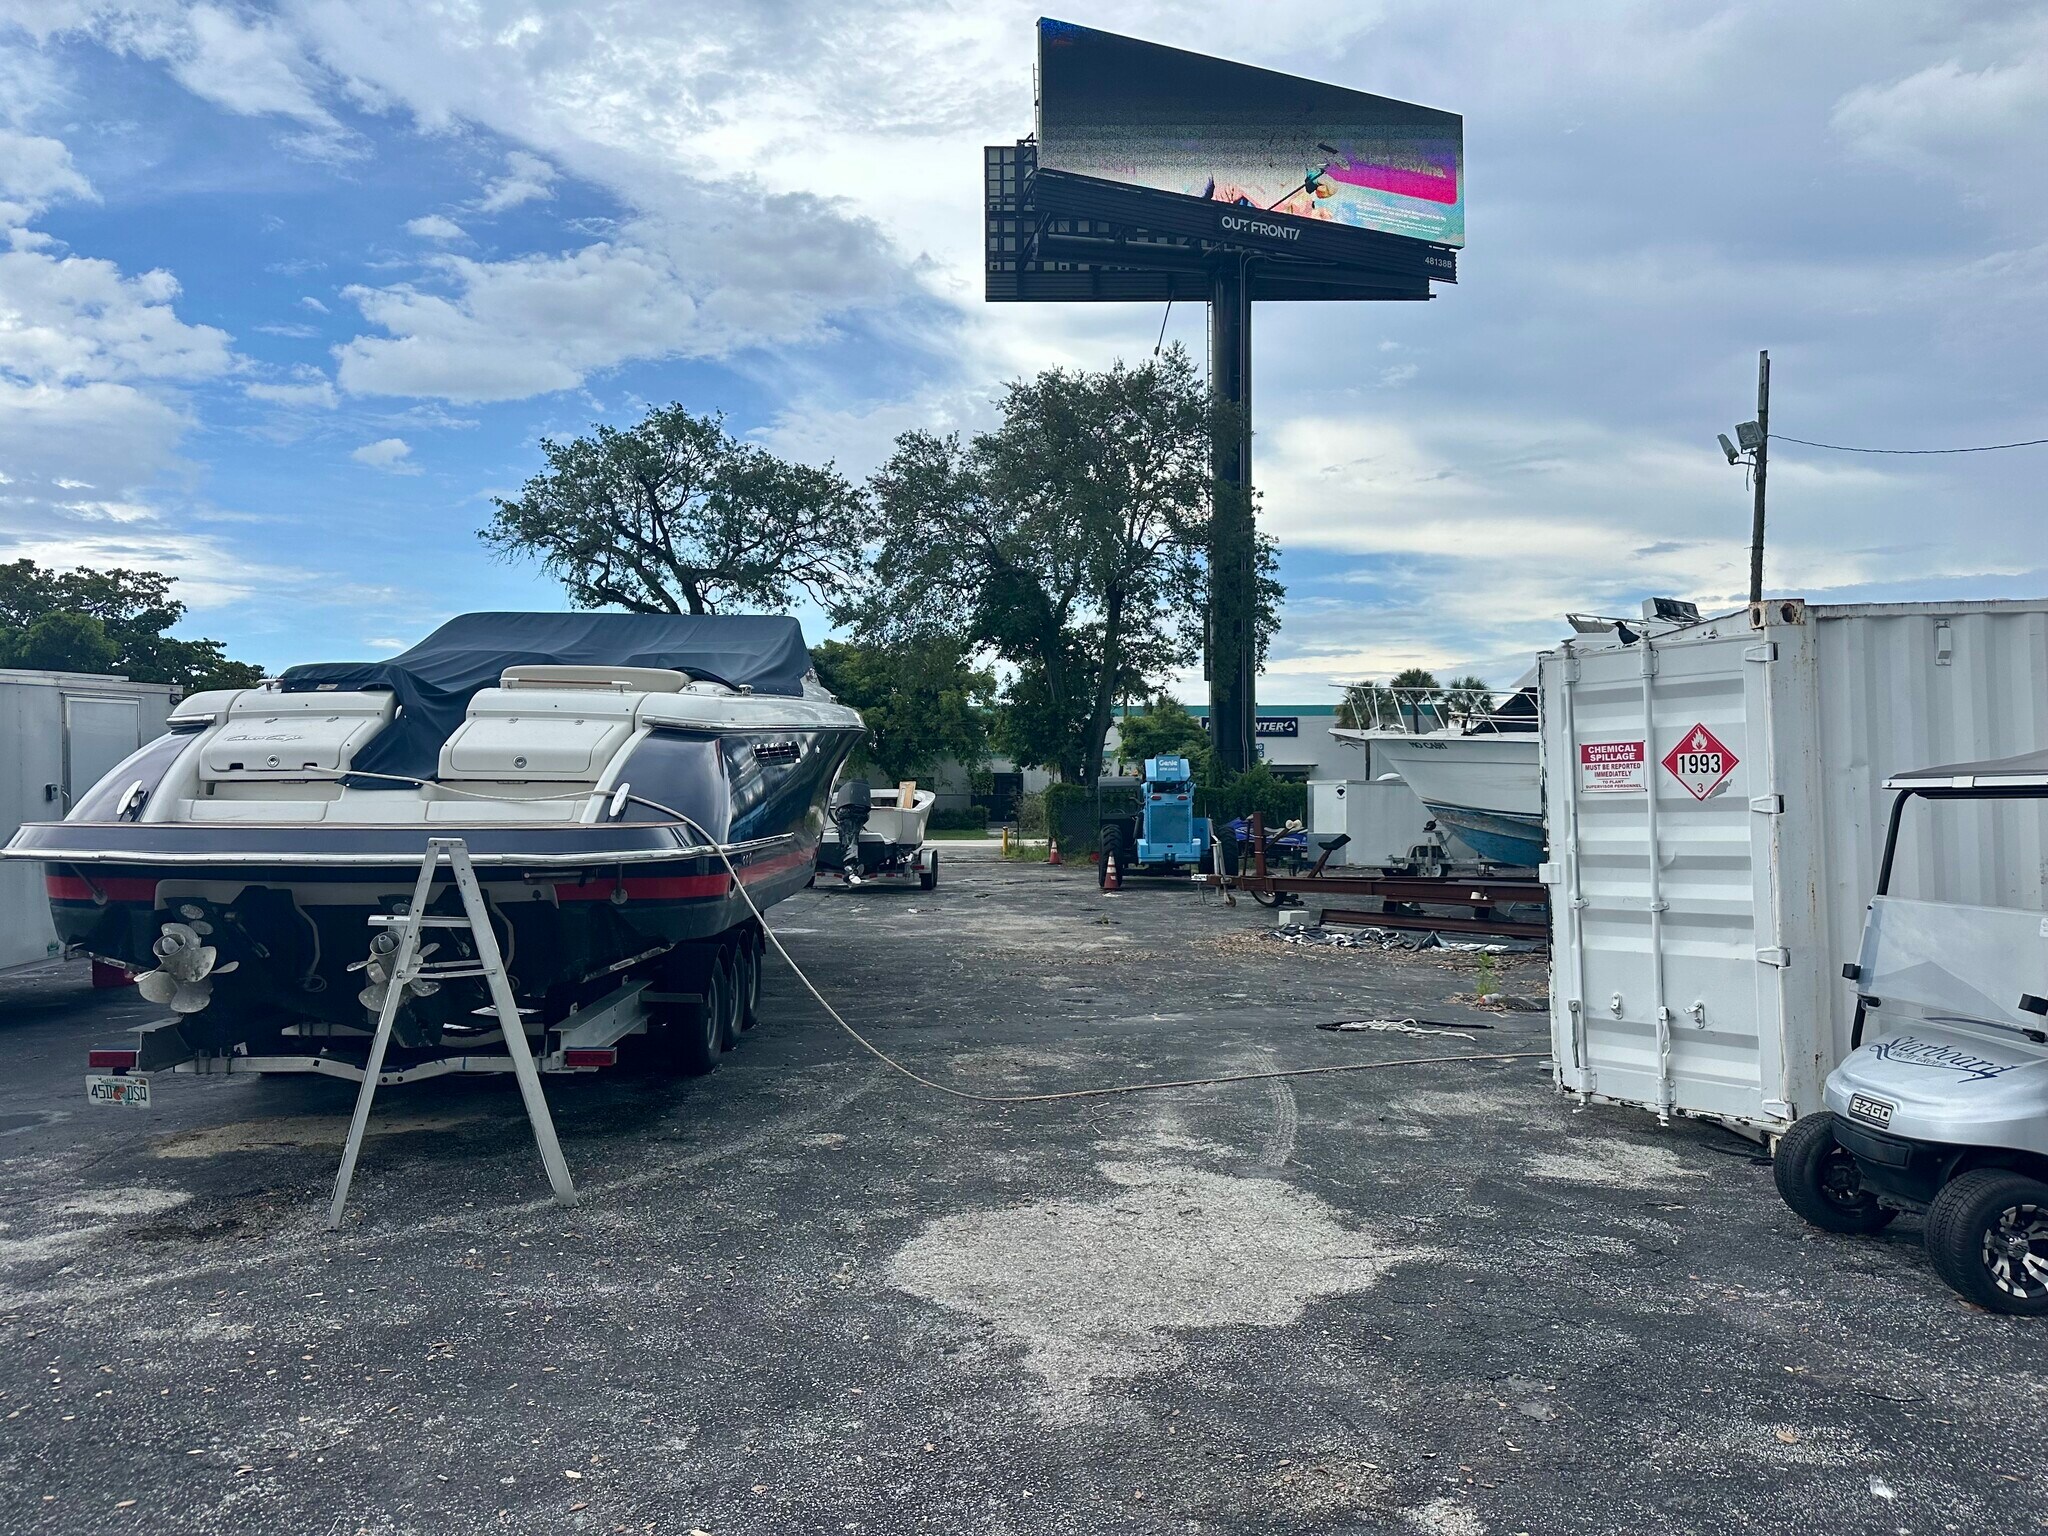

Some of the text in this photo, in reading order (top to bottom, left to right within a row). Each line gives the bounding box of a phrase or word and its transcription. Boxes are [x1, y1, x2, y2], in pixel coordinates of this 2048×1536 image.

[1424, 256, 1453, 269] 48138B
[1255, 721, 1285, 731] NTER
[1588, 744, 1637, 754] CHEMICAL
[1590, 752, 1636, 762] SPILLAGE
[1158, 759, 1178, 767] Genie
[1678, 754, 1721, 774] 1993
[1594, 770, 1632, 778] IMMEDIATELY
[1697, 782, 1704, 793] 3
[1869, 1035, 2021, 1078] Starboard
[1890, 1051, 1947, 1068] YACHT GROUP
